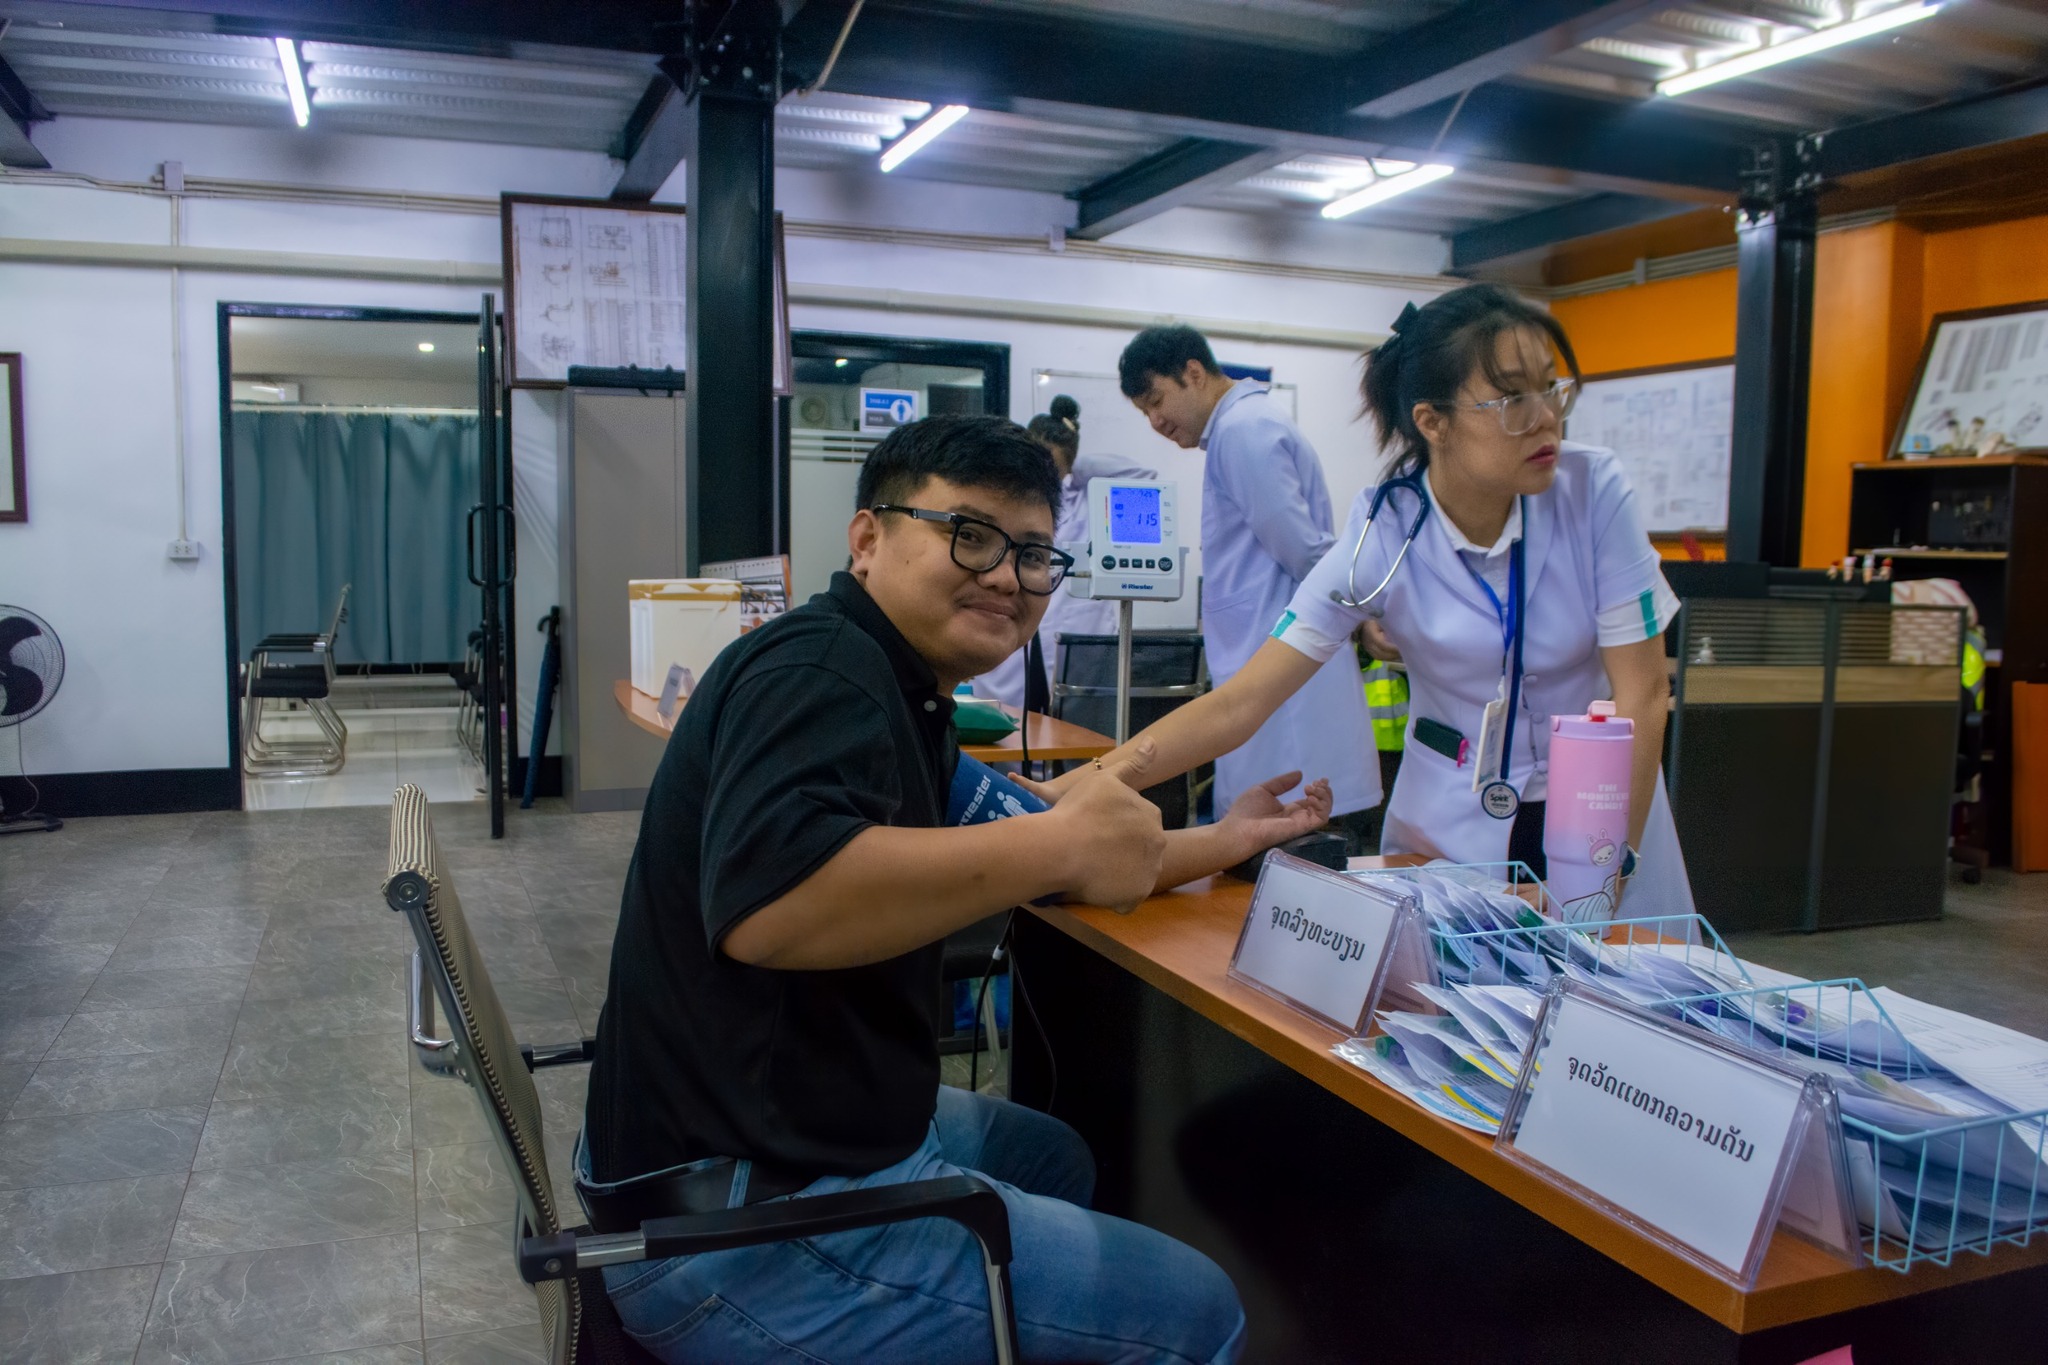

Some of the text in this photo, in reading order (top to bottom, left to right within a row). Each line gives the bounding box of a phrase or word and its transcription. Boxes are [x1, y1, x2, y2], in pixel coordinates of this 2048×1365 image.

[1137, 512, 1158, 526] 115
[1127, 583, 1154, 591] Riester
[1271, 906, 1365, 961] ຈຸດລົງທະບຽນ
[1568, 1056, 1755, 1162] ຈຸດວັດແທກຄວາມດັນ
